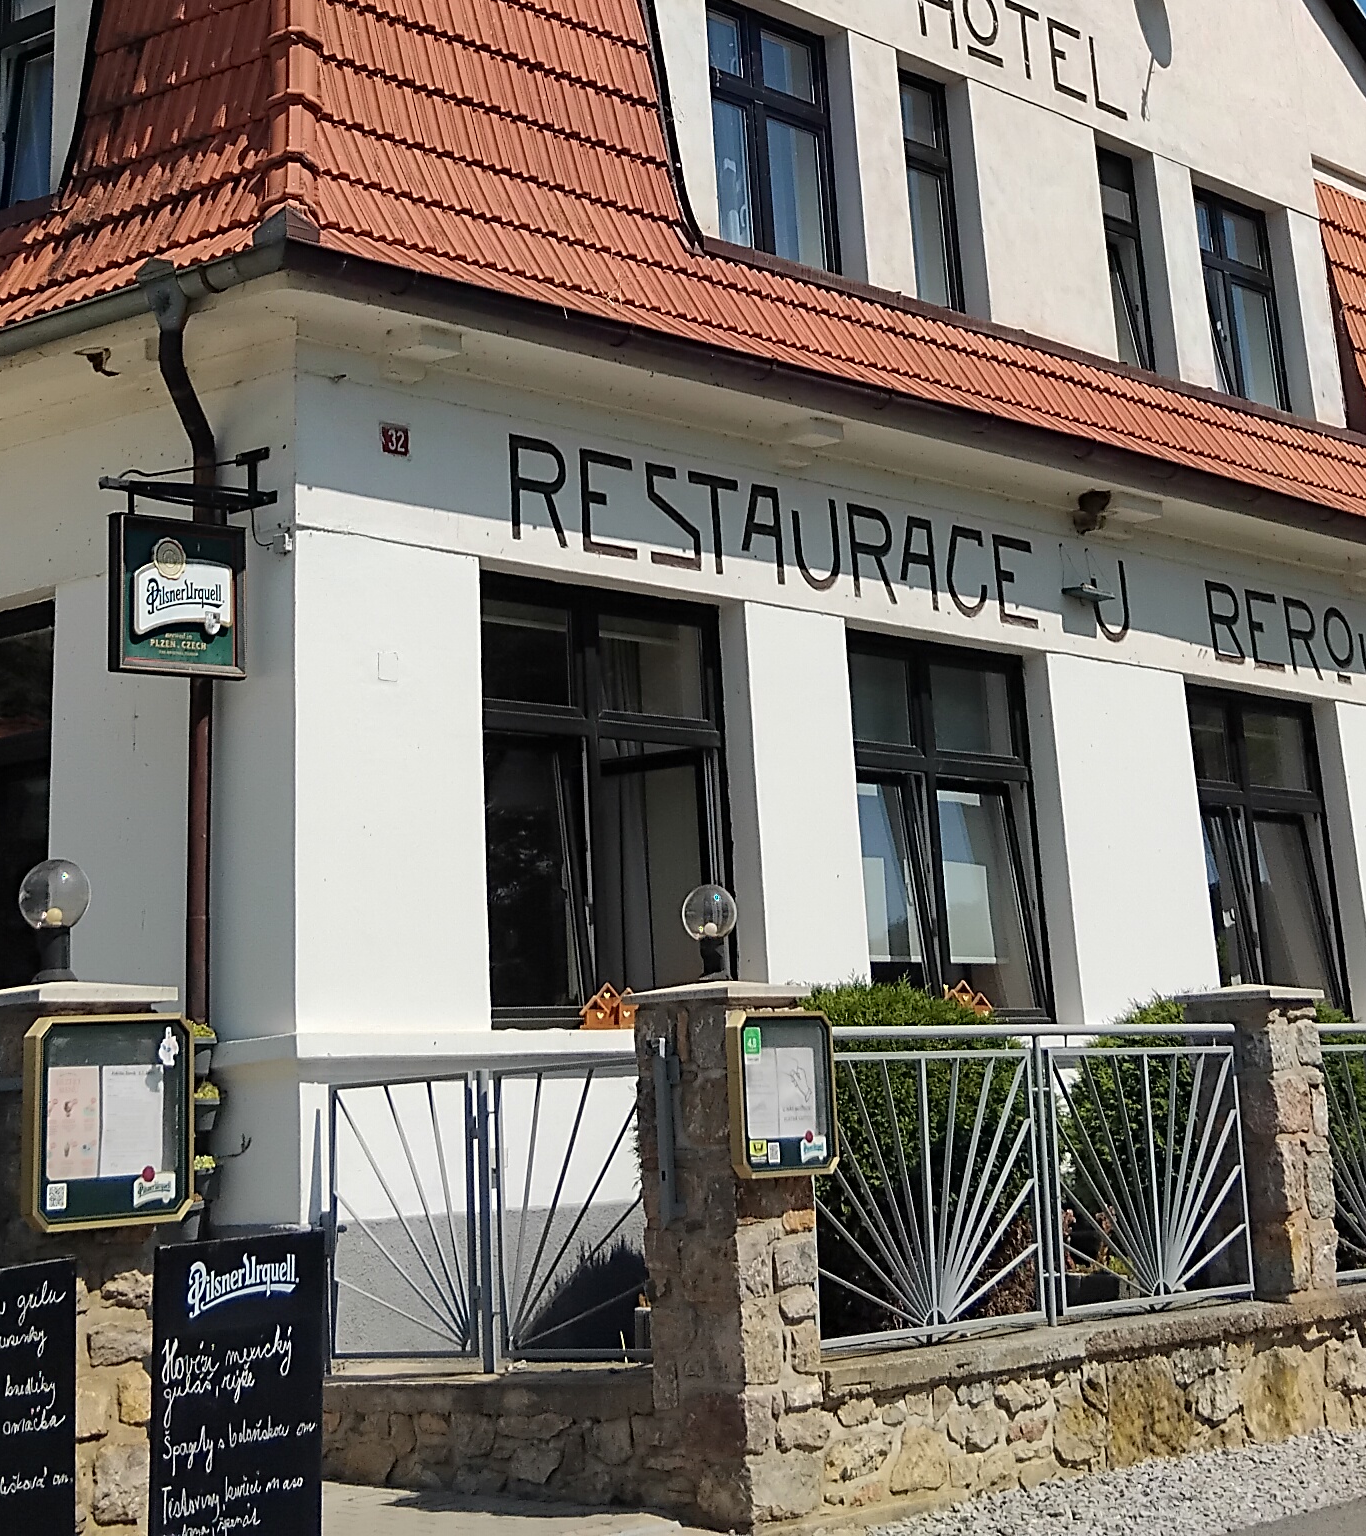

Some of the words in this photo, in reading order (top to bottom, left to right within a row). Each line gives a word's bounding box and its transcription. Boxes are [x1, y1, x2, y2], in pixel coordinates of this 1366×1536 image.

[387, 429, 406, 452] 32
[508, 432, 1039, 630] RESTAURACE
[1089, 559, 1131, 640] U
[146, 577, 185, 615] Pilsner
[187, 1261, 245, 1318] Pilsner
